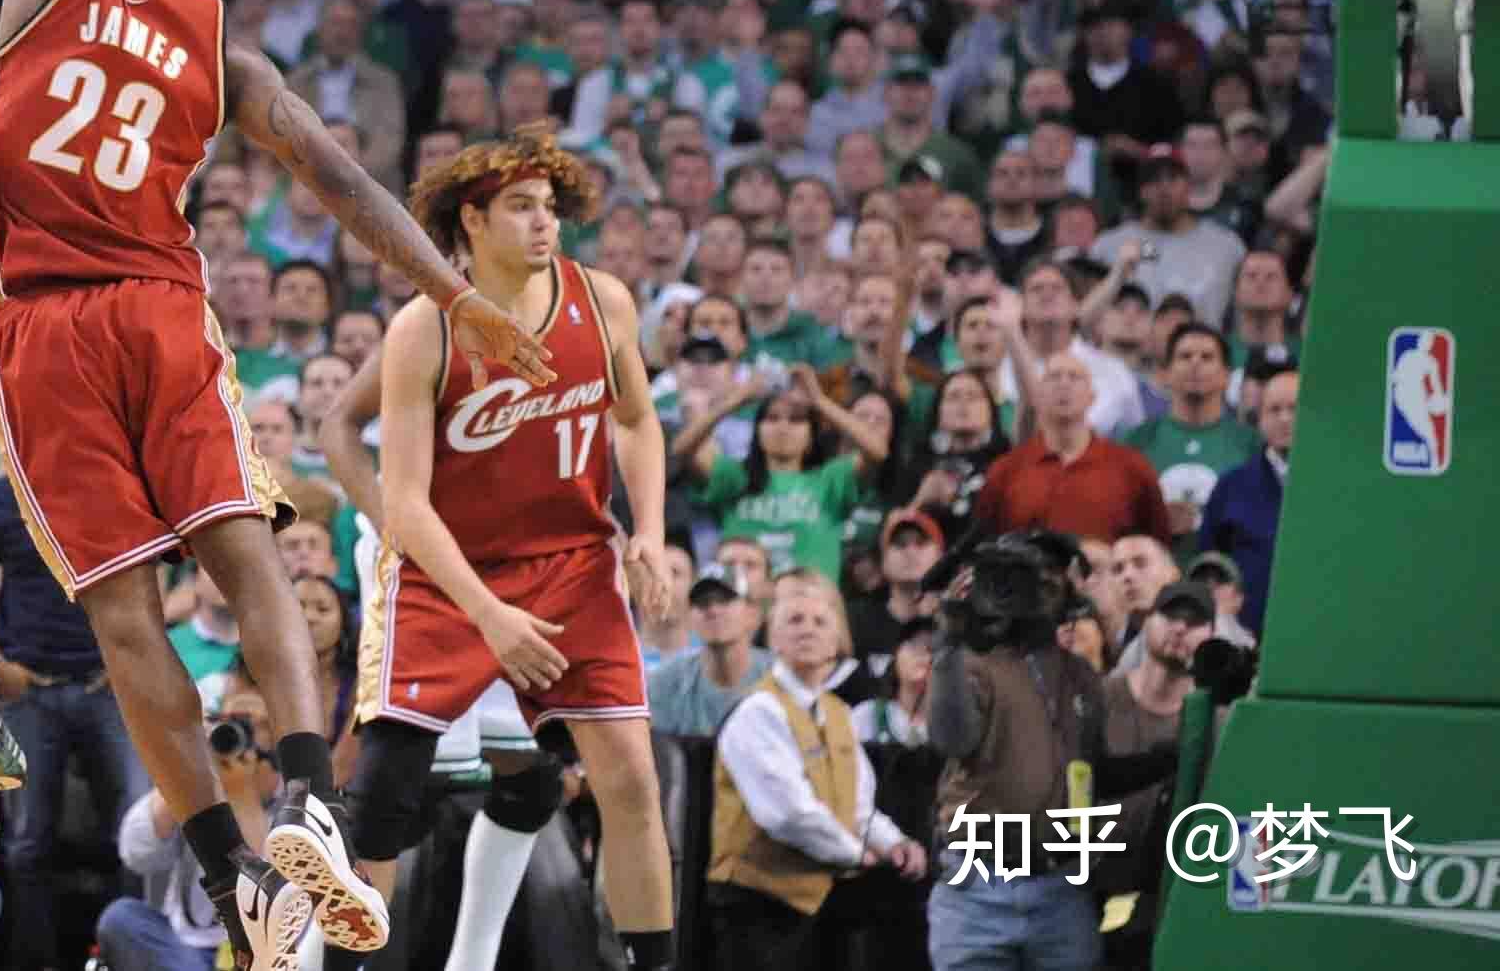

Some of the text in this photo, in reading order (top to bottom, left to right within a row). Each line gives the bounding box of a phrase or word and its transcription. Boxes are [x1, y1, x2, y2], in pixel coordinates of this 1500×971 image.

[79, 1, 189, 80] JAMES
[27, 58, 167, 193] 23
[446, 377, 605, 453] CLEVELAND
[554, 412, 600, 480] 17
